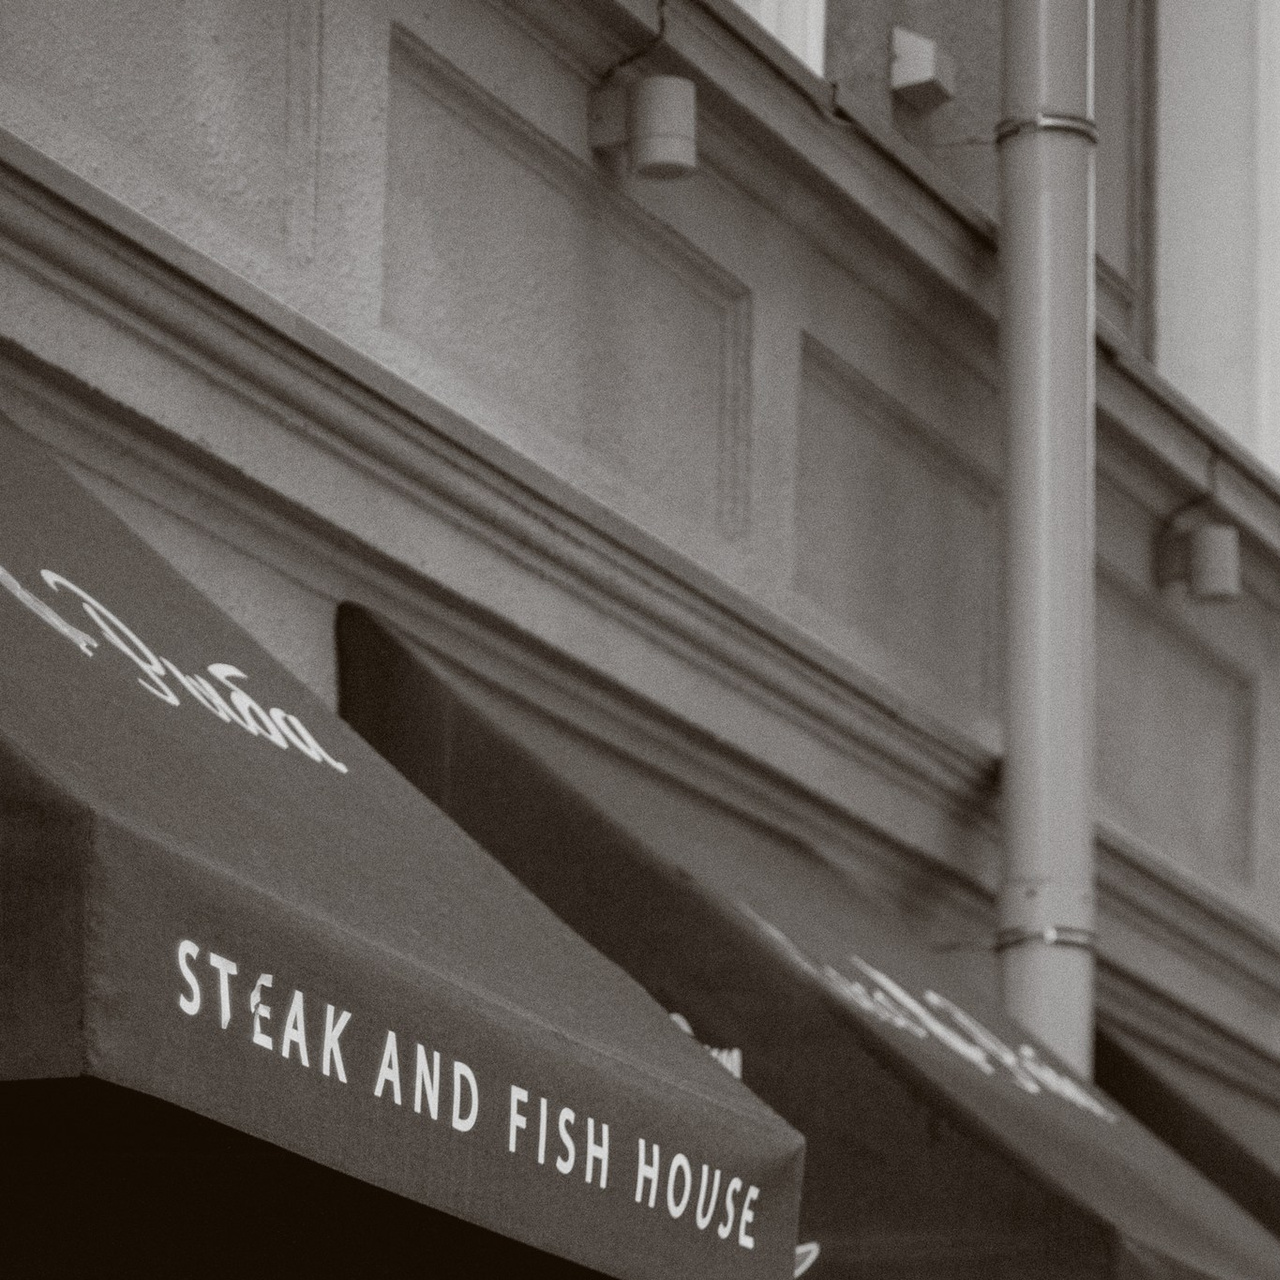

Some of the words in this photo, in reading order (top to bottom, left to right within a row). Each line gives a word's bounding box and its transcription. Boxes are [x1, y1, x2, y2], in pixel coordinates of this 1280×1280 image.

[177, 939, 352, 1083] STEAK
[373, 1030, 479, 1132] AND
[508, 1085, 610, 1189] FISH
[635, 1138, 760, 1250] HOUSE
